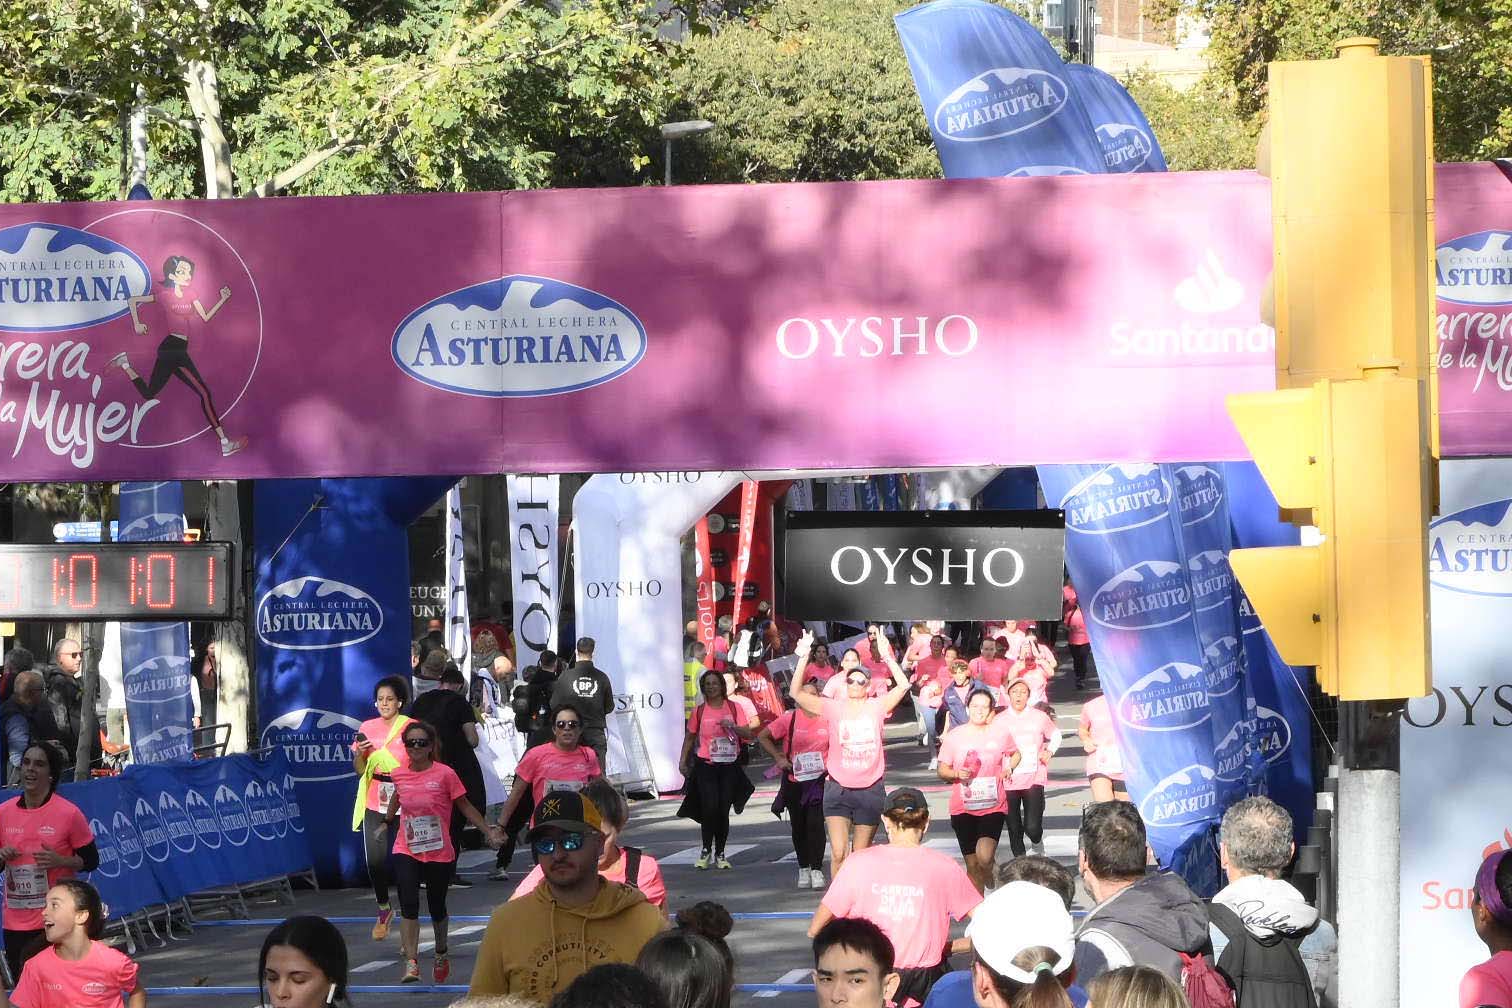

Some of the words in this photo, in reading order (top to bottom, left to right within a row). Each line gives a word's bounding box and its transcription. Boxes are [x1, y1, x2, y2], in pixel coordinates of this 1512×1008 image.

[53, 259, 126, 270] LECHERA
[450, 317, 529, 331] CENTRAL
[537, 315, 618, 328] LECHERA
[775, 314, 978, 359] OYSHO
[411, 322, 627, 367] ASTURIANA
[1459, 341, 1477, 369] la
[12, 374, 161, 469] Mujer
[830, 545, 1024, 587] OYSHO
[587, 579, 662, 599] OYSHO
[274, 601, 316, 610] CENTRAL
[321, 601, 369, 609] LECHERA
[261, 607, 374, 634] ASTURIANA
